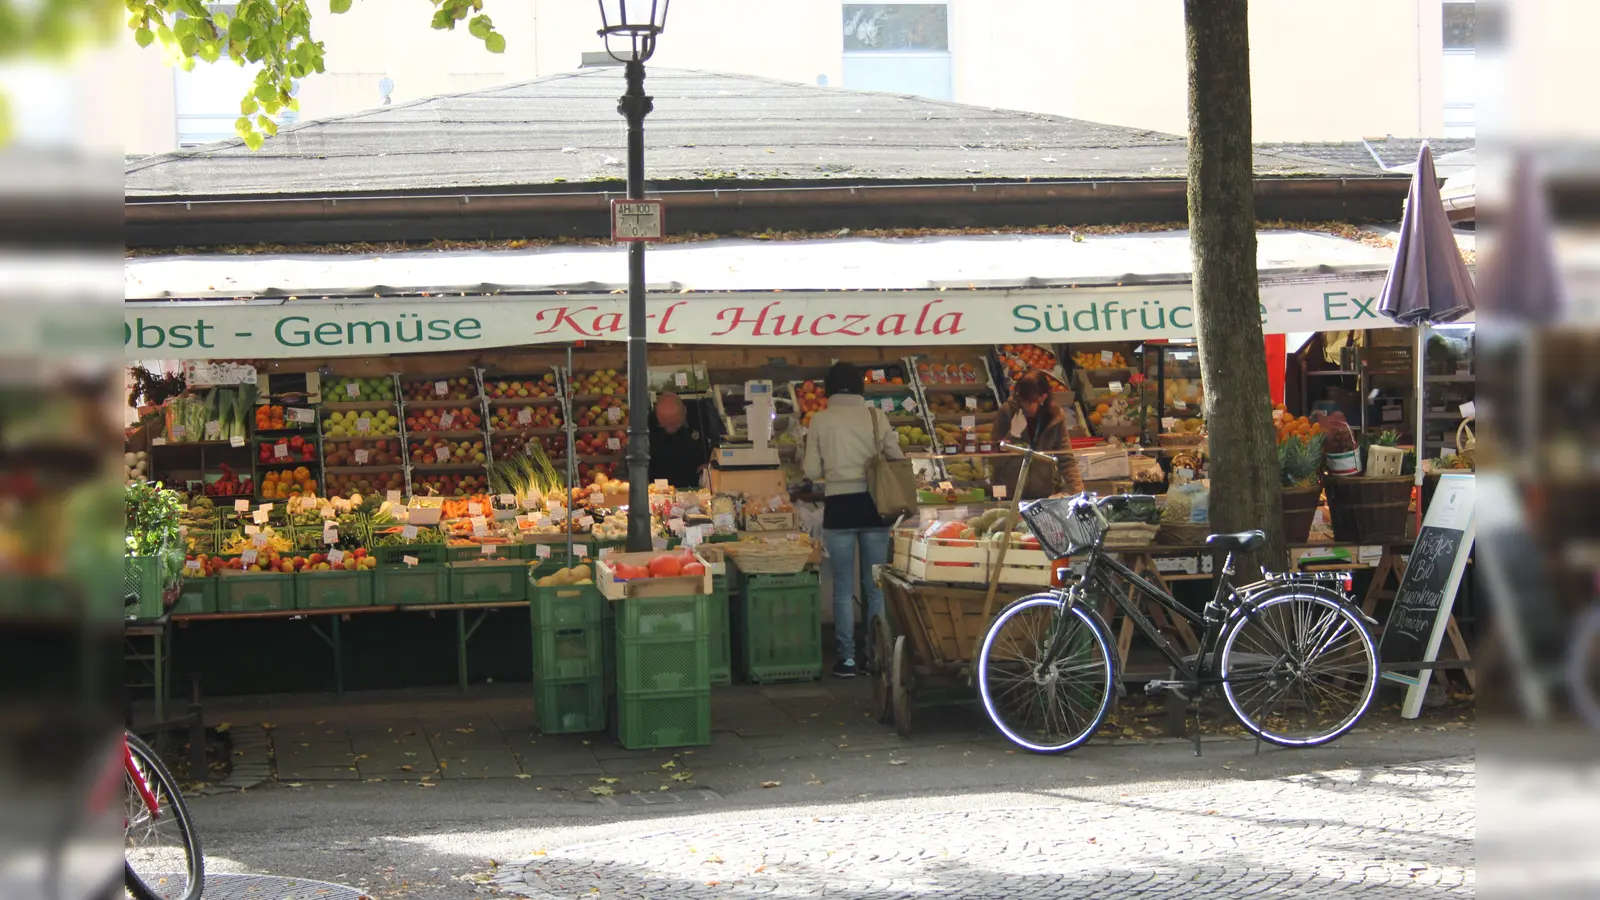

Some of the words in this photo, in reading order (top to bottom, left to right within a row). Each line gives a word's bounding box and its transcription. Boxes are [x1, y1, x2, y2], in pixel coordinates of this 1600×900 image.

[636, 204, 650, 214] 100
[125, 317, 215, 349] bst
[274, 313, 482, 347] Gemüse
[533, 301, 688, 337] Kal
[710, 299, 967, 337] Huczala
[1012, 299, 1268, 333] Südfrüc
